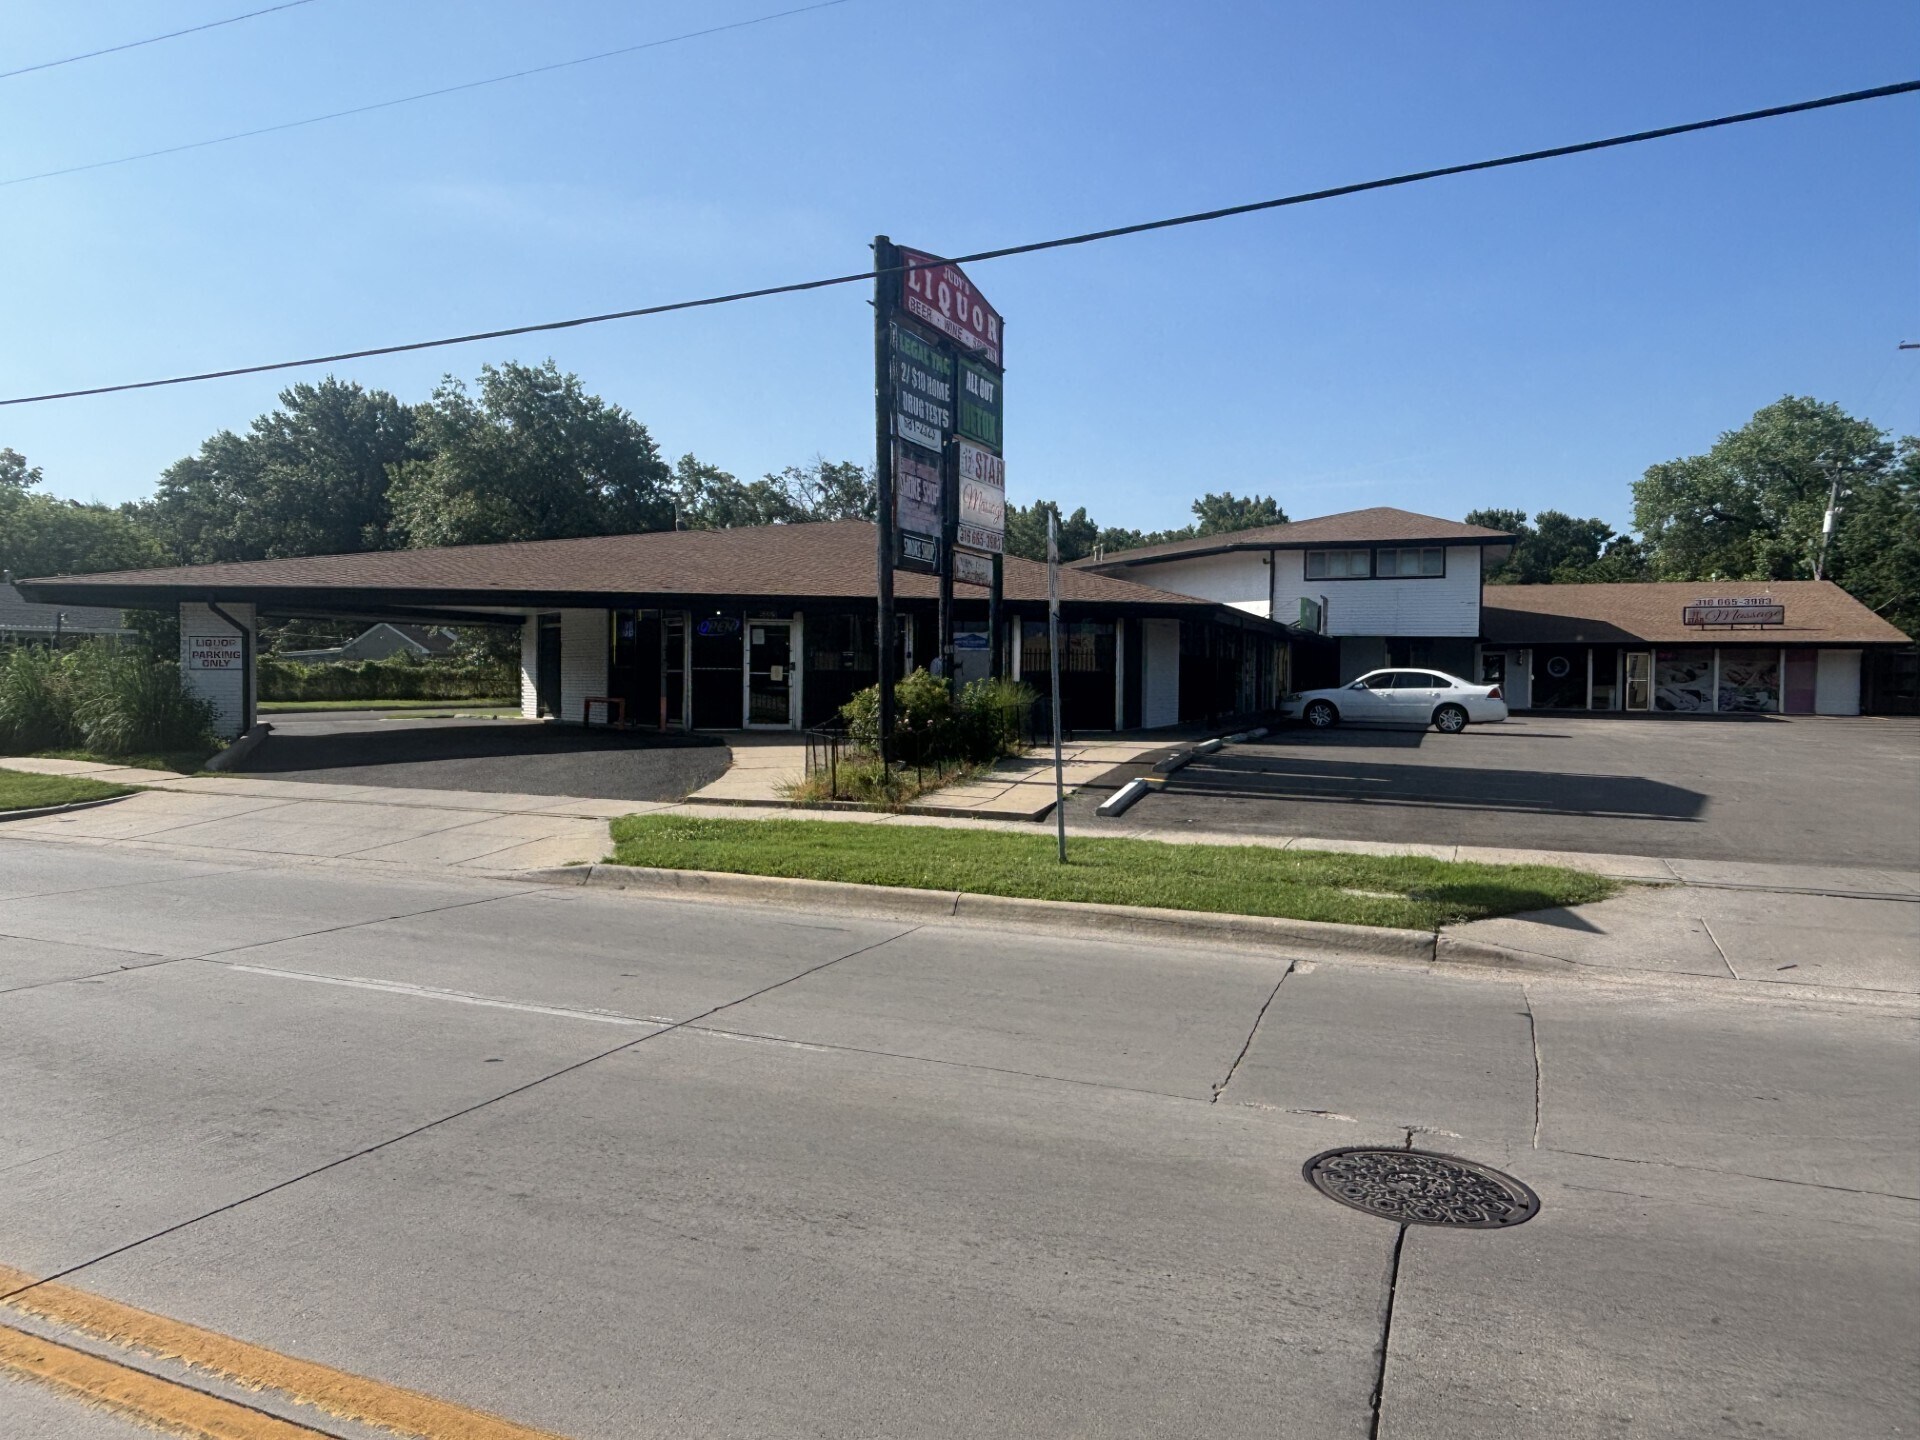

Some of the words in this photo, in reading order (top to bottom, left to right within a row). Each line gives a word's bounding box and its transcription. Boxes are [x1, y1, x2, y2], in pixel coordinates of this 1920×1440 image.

[908, 259, 998, 343] LIQUOR
[909, 297, 932, 321] BEER
[944, 319, 963, 341] WINE
[900, 333, 929, 366] LEGAL
[911, 366, 926, 391] $10
[927, 375, 951, 402] HOME
[965, 370, 979, 397] ALL
[979, 378, 994, 404] OUT
[902, 391, 925, 419] DRUG
[924, 401, 949, 428] TESTS
[975, 452, 1004, 487] STAR
[195, 639, 237, 647] LIQUOR
[699, 620, 740, 634] OPEN
[192, 651, 241, 659] PARKING
[202, 660, 231, 668] ONLY
